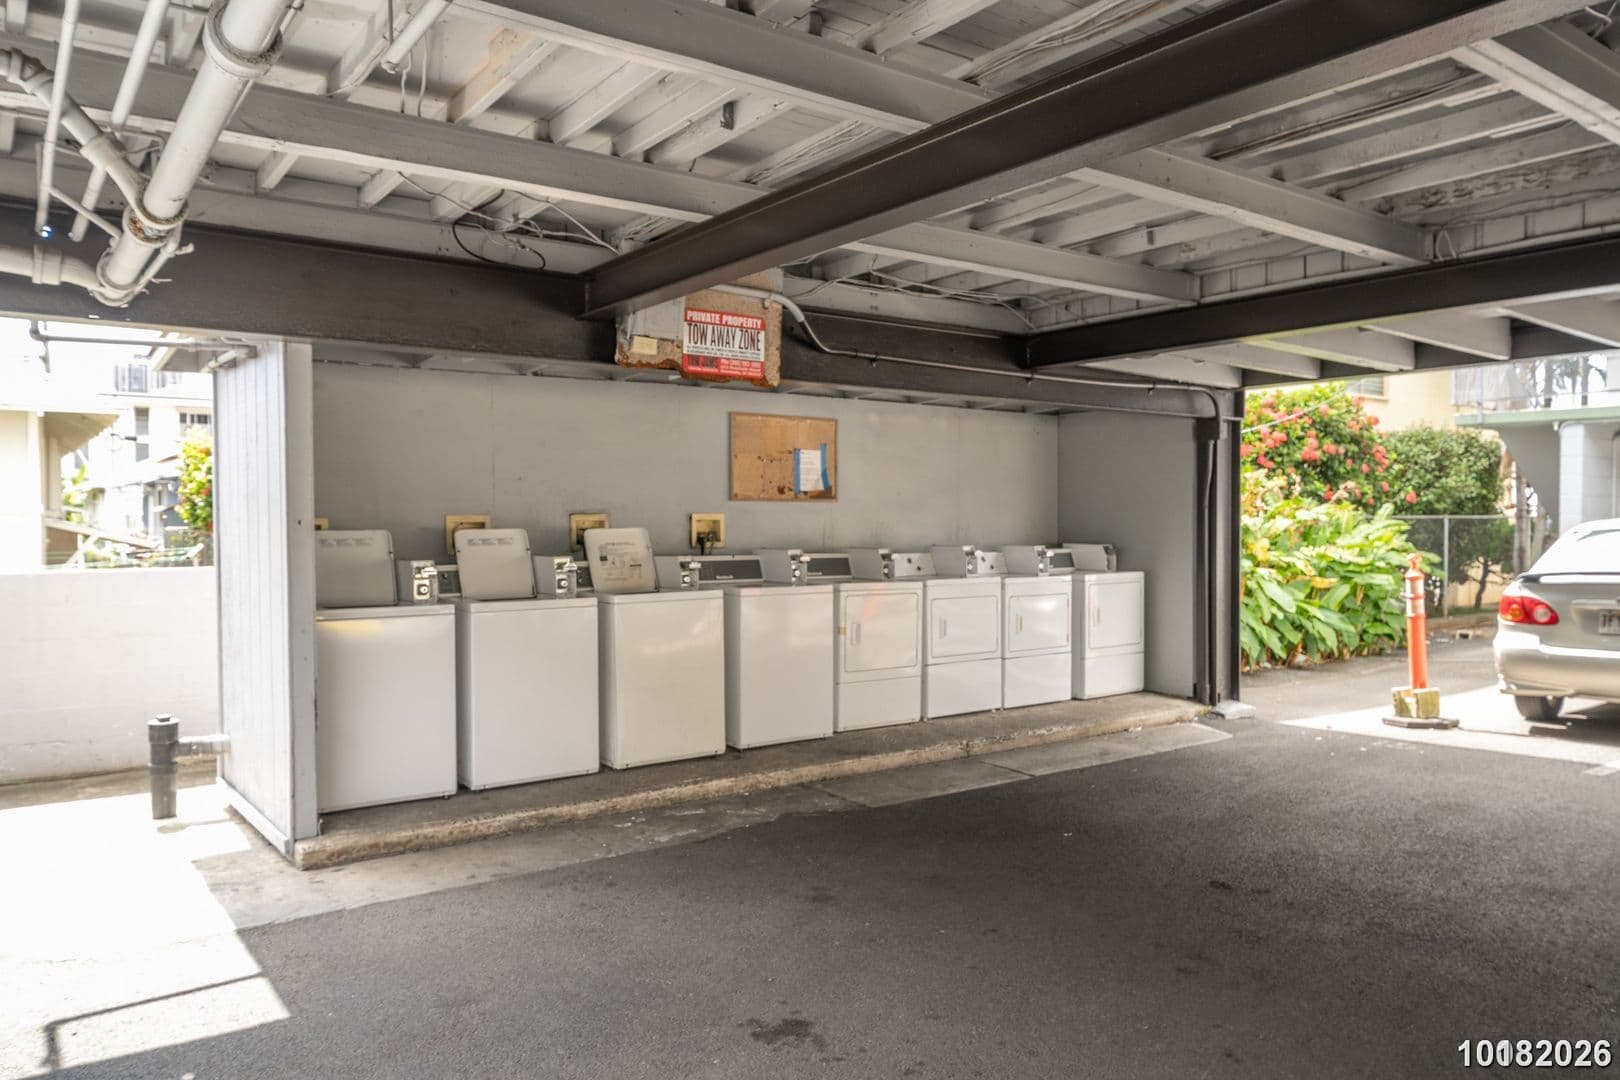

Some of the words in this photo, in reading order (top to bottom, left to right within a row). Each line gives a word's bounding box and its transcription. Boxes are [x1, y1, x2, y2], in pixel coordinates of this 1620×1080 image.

[687, 311, 720, 324] PRIVATE
[722, 314, 762, 329] PROPERTY
[687, 323, 708, 345] TOW
[711, 326, 736, 349] AWAY
[739, 329, 761, 351] ZONE
